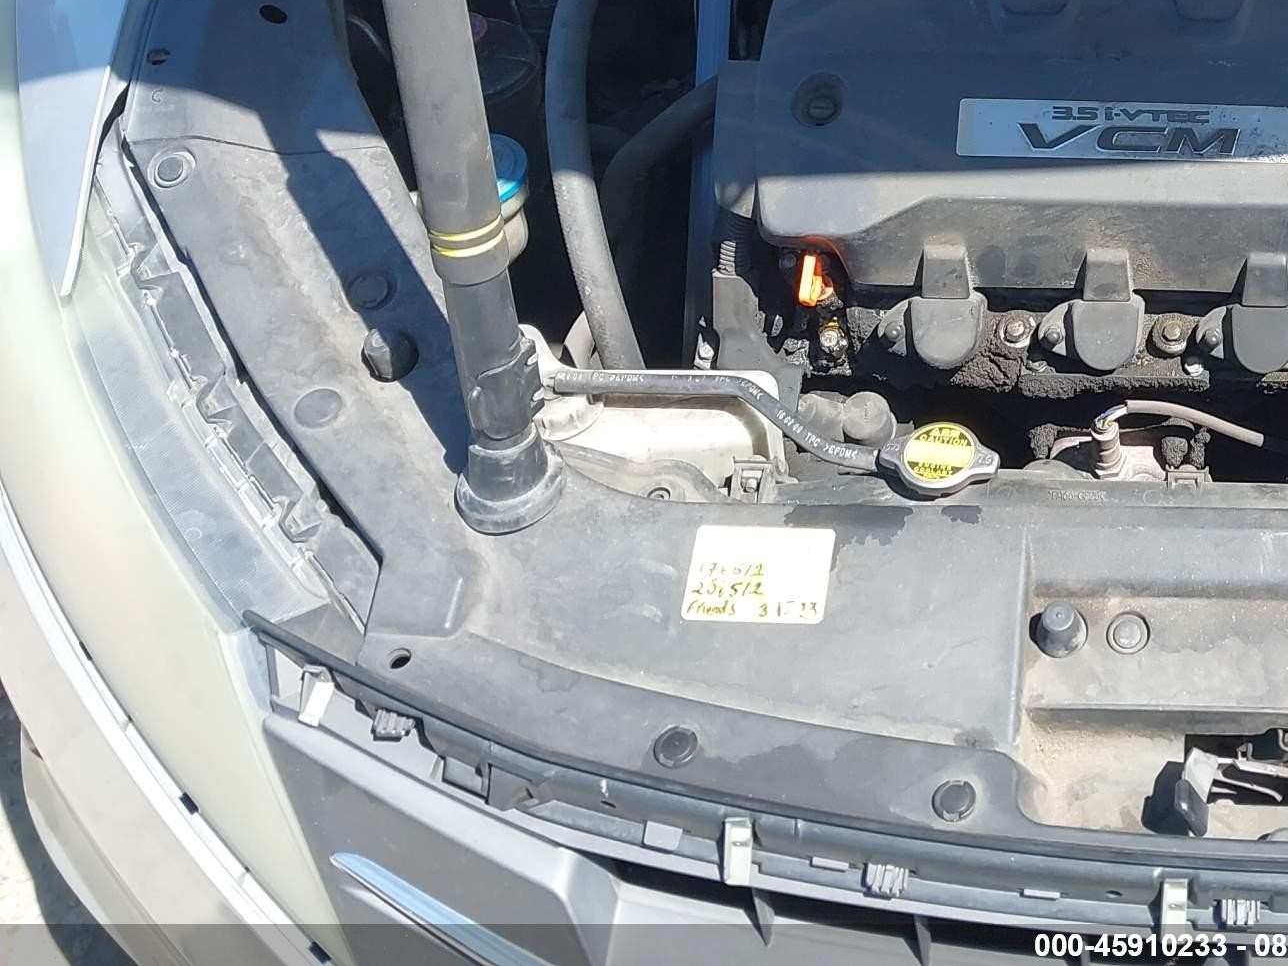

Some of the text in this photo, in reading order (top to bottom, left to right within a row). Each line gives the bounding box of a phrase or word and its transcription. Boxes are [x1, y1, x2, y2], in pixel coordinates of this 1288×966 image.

[1051, 106, 1211, 124] 3.5 i-VTEC
[1017, 121, 1242, 155] VCM
[919, 434, 968, 446] CAUTION
